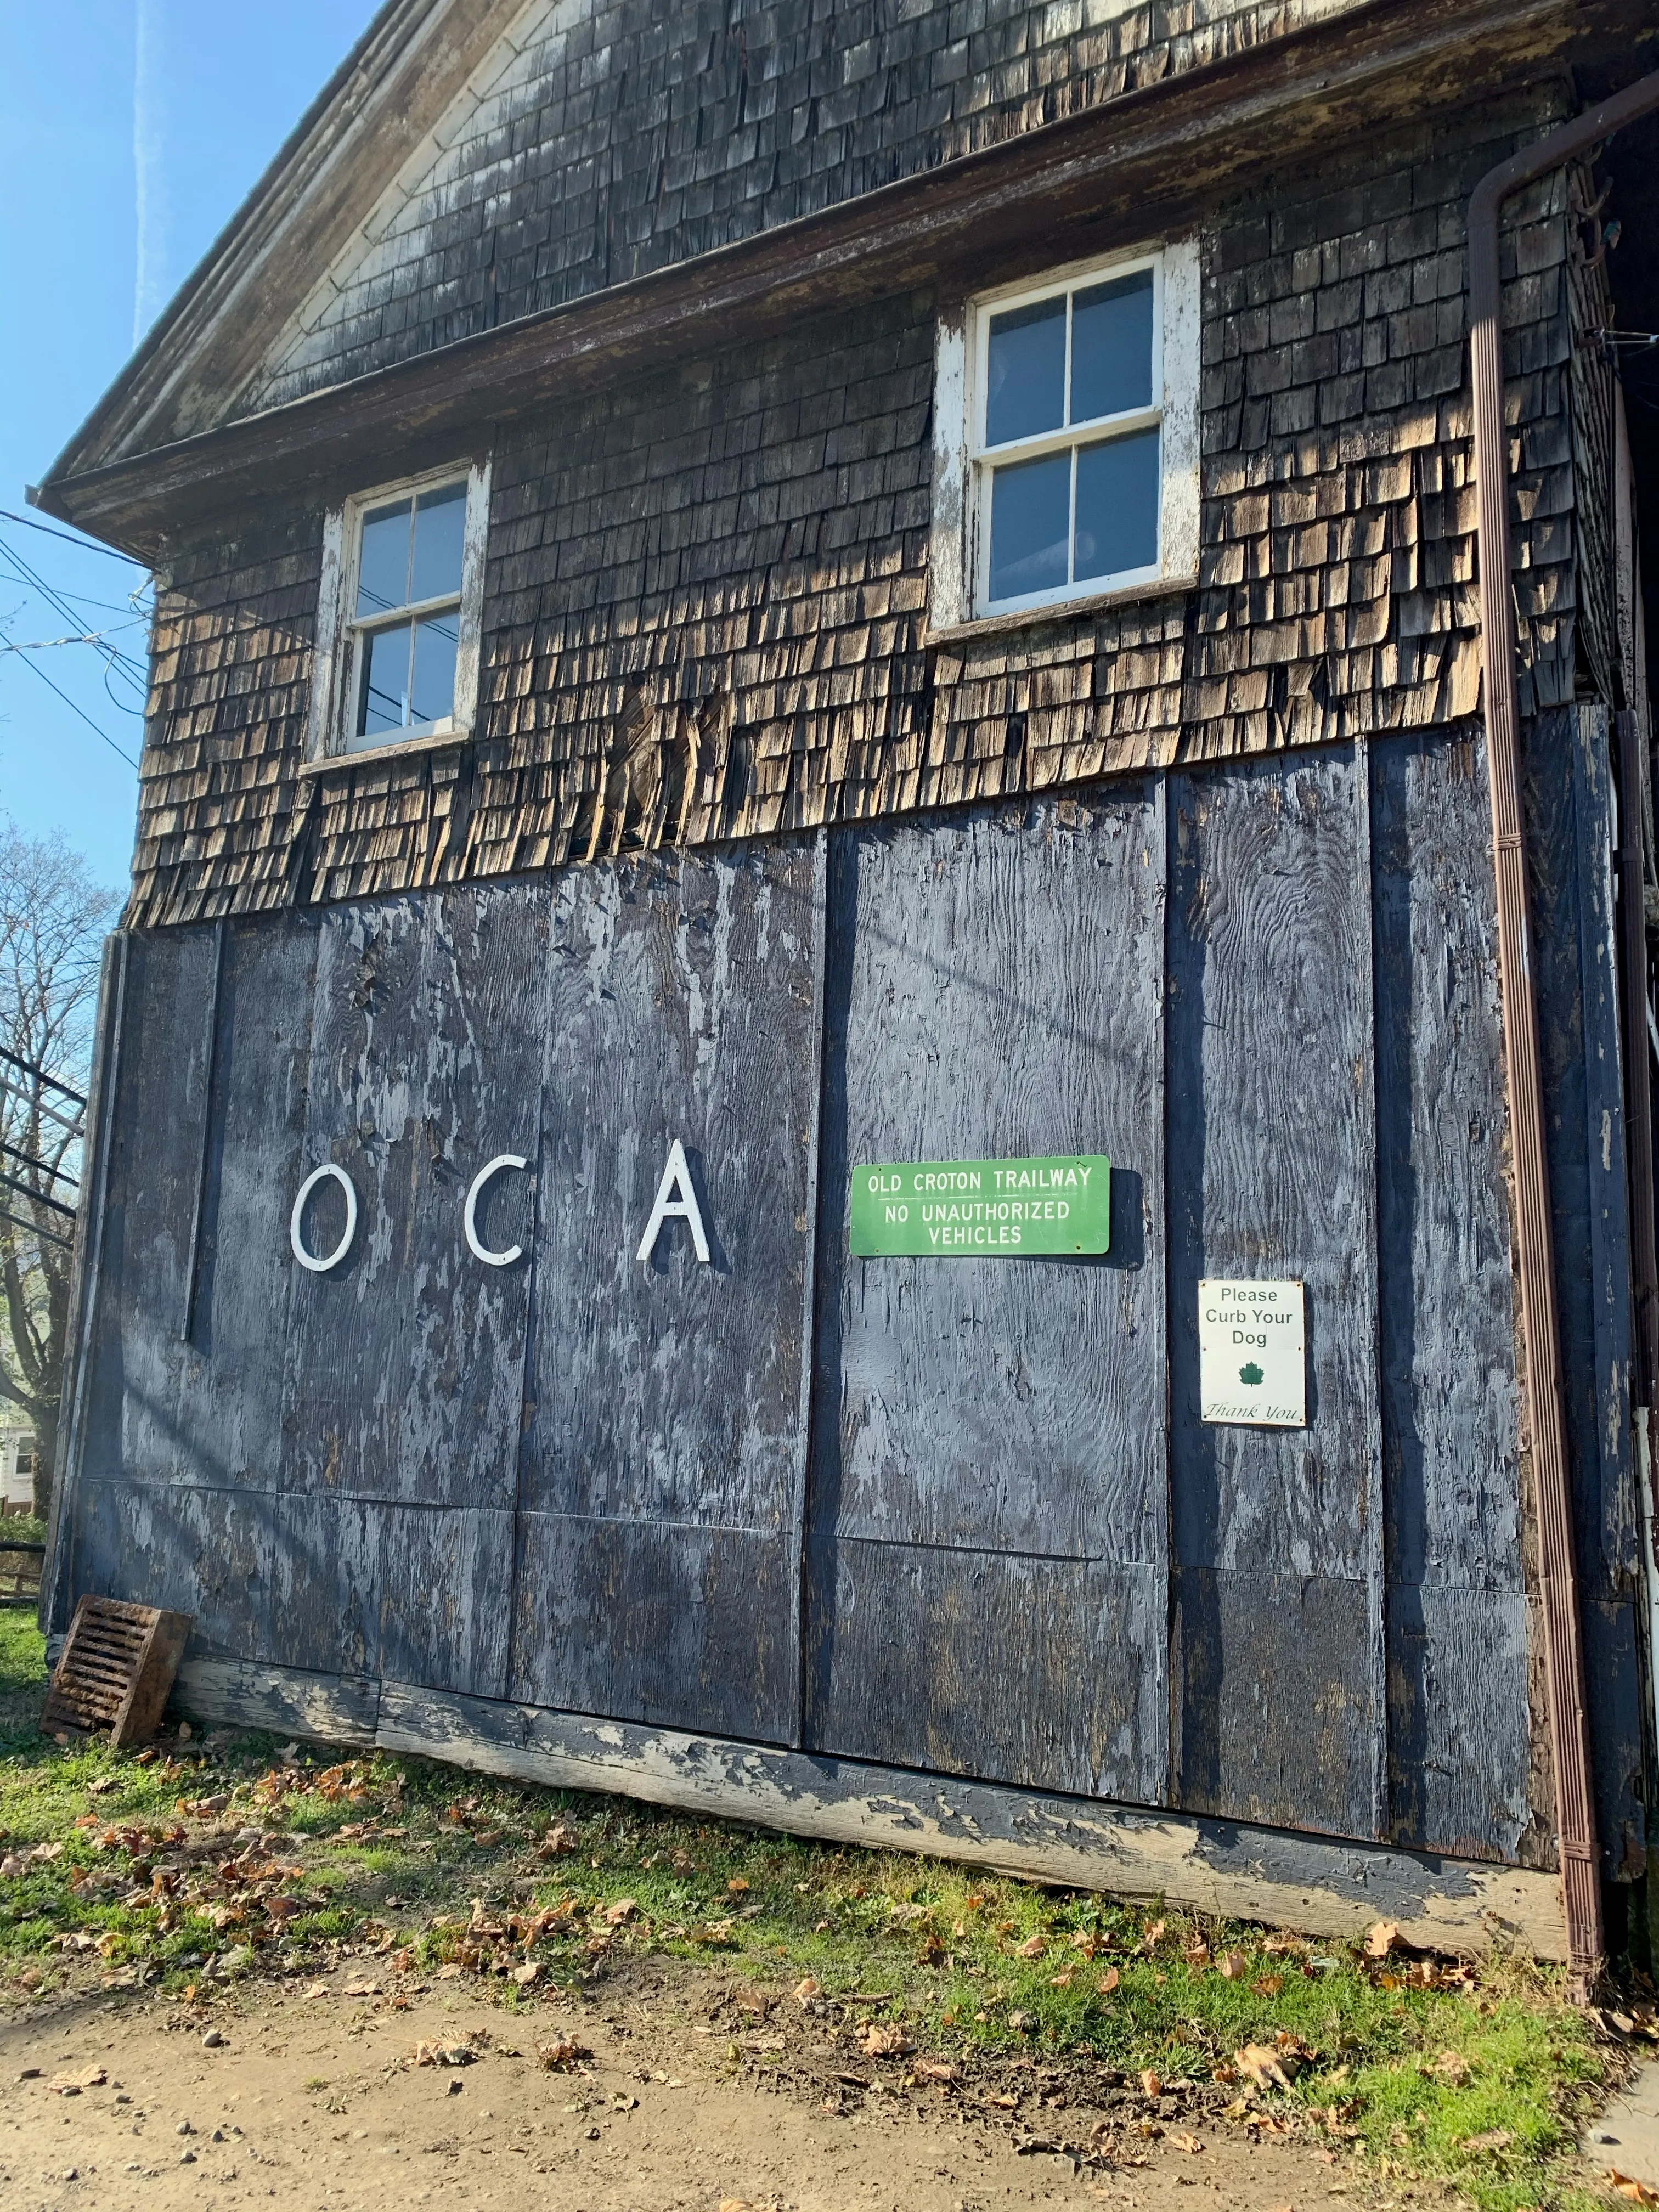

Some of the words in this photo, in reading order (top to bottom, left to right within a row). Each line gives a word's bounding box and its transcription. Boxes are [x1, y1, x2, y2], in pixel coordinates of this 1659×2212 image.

[868, 1174, 901, 1193] OLD
[913, 1171, 981, 1192] CROTON
[994, 1167, 1092, 1189] TRAILWAY
[885, 1205, 909, 1223] NO
[922, 1201, 1070, 1222] UNAUTHORIZED
[929, 1226, 1022, 1245] VEHICLES
[1221, 1288, 1278, 1302] Please
[1206, 1308, 1246, 1323] Curb
[1252, 1309, 1293, 1324] Your
[1232, 1330, 1267, 1348] Dog
[1206, 1402, 1261, 1418] Thank
[1262, 1405, 1298, 1421] You
